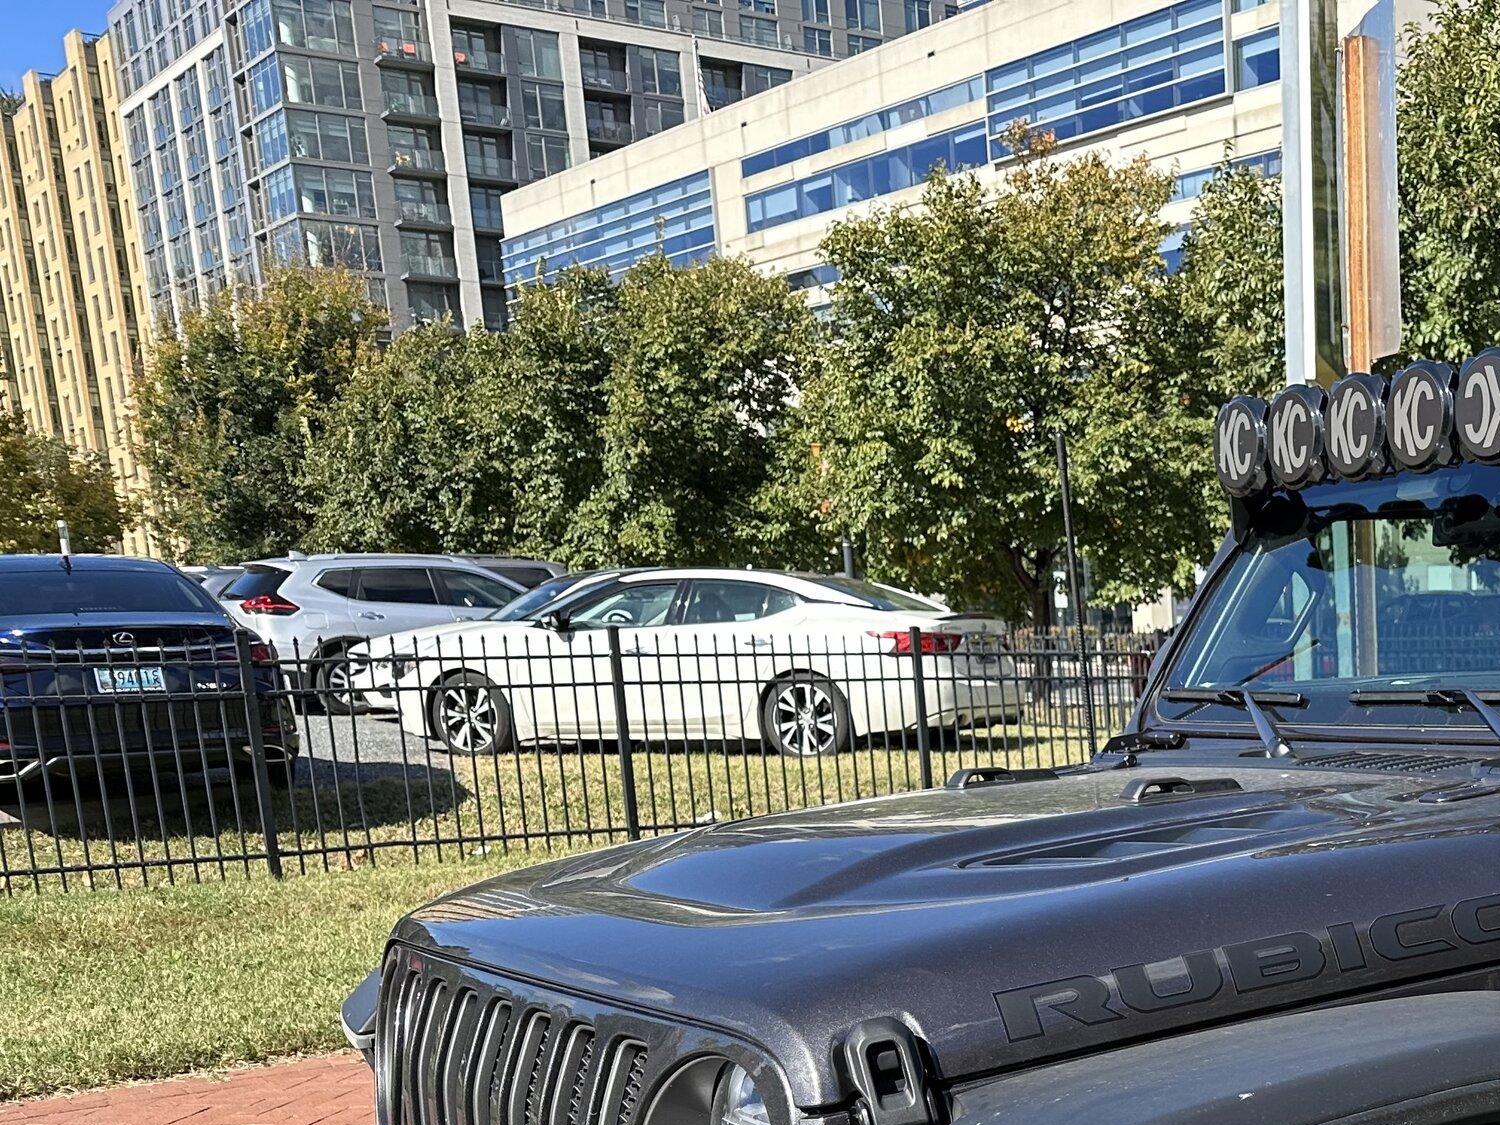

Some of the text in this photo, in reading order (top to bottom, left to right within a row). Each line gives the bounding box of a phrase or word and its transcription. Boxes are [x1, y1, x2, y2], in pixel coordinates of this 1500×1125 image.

[1219, 409, 1251, 480] KC
[1273, 400, 1306, 474] KC
[1330, 387, 1367, 464] KC
[1394, 376, 1434, 457] KC
